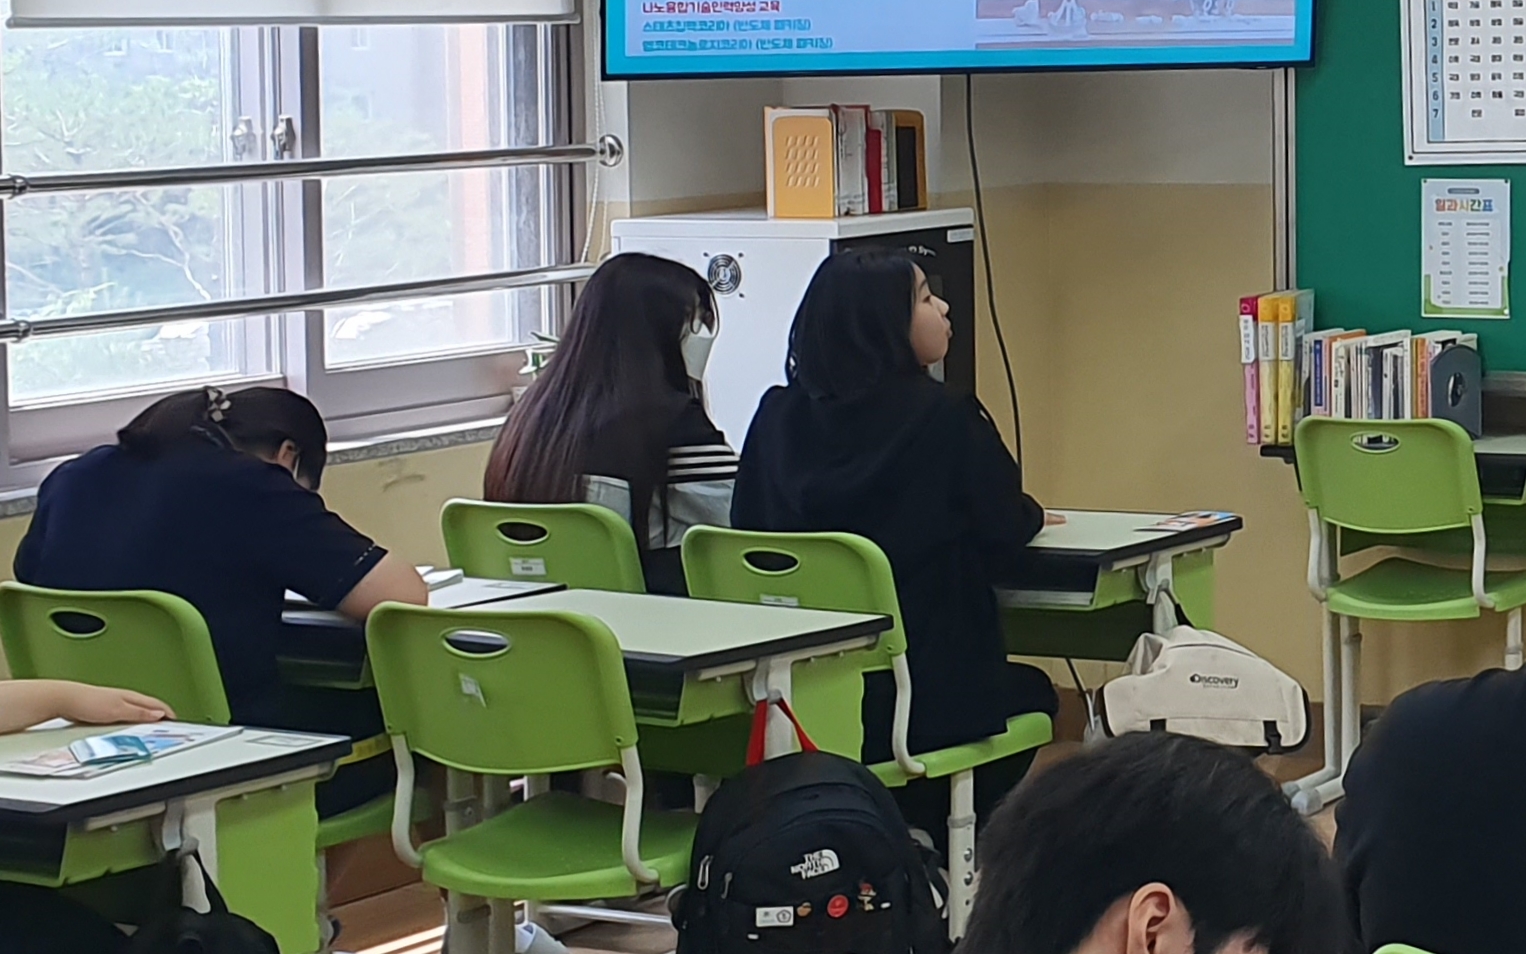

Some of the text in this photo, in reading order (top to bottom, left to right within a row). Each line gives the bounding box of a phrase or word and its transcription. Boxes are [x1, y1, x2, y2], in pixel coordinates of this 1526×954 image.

[759, 0, 781, 13] 교육
[1430, 18, 1438, 29] 2
[1431, 36, 1438, 47] 3
[1431, 54, 1438, 65] 4
[1431, 72, 1439, 83] 5
[1432, 90, 1439, 101] 6
[1432, 108, 1439, 118] 7
[1434, 198, 1494, 213] 일과시간표
[1189, 673, 1239, 688] Discovery
